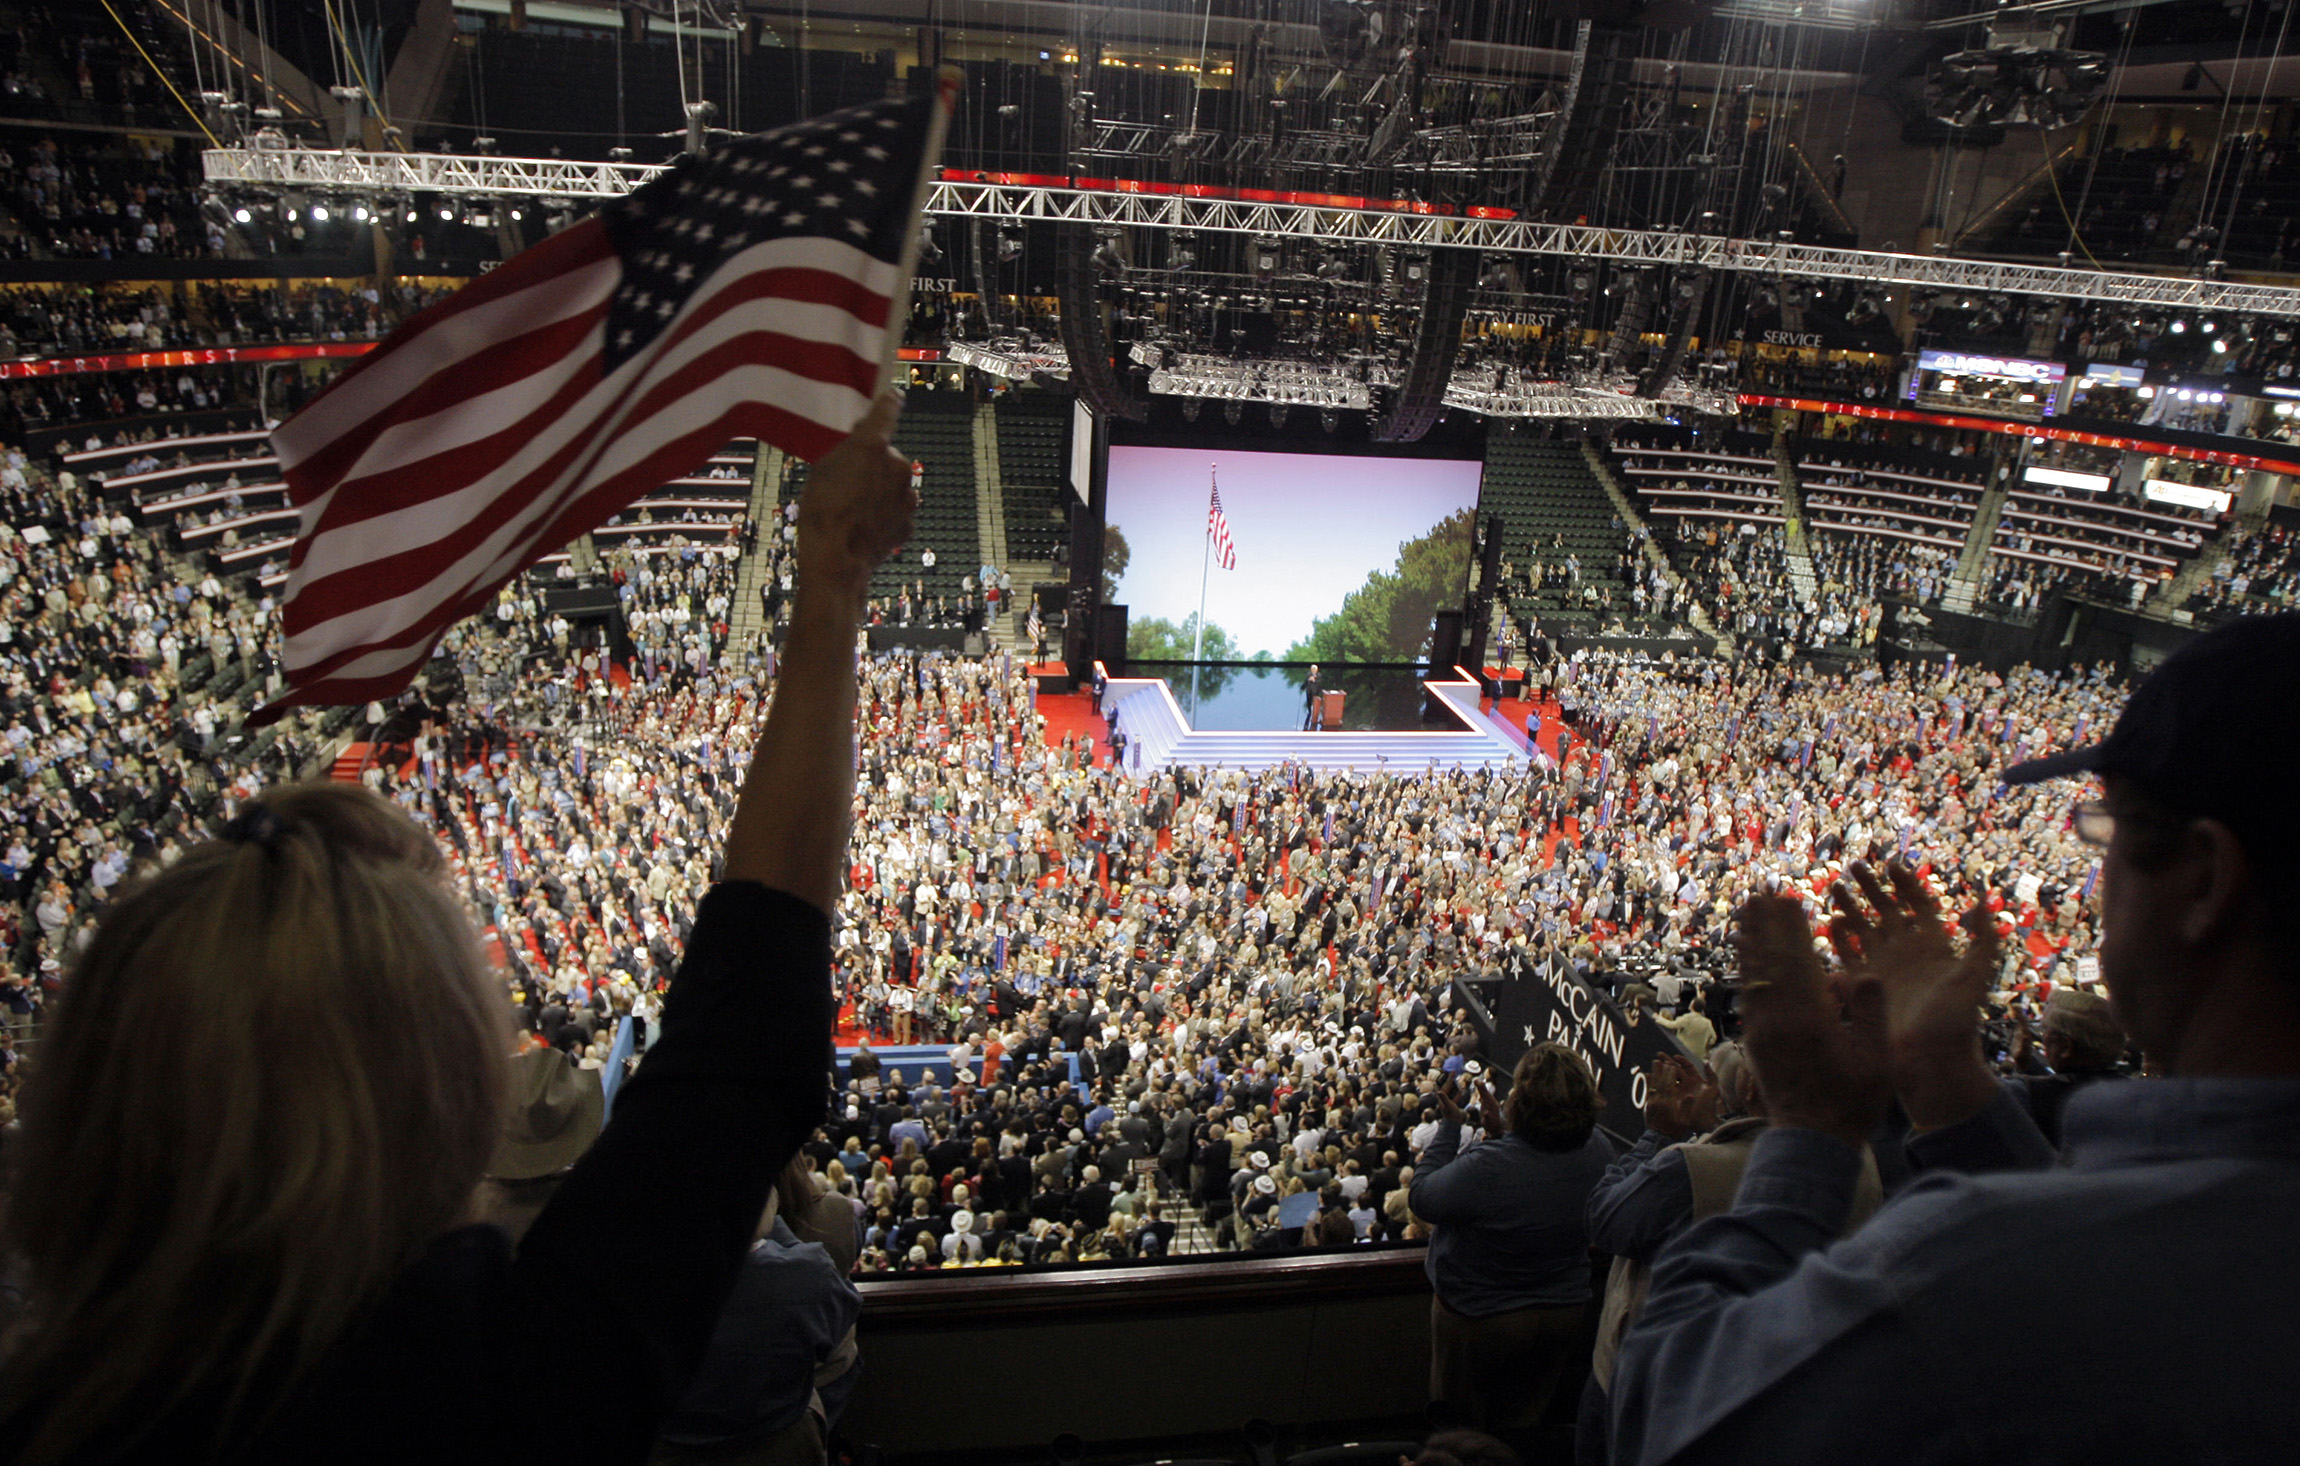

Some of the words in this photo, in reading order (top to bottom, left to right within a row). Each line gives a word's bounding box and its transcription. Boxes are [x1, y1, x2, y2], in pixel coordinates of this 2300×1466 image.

[910, 277, 957, 292] FIRST
[1514, 312, 1556, 327] FIRST
[1763, 329, 1823, 348] SERVICE
[142, 348, 237, 368] FIRST
[1954, 356, 2050, 379] MSNBC
[1821, 402, 1897, 421] FIRST
[2003, 423, 2142, 451] COUNTRY
[2168, 445, 2261, 469] FIRST
